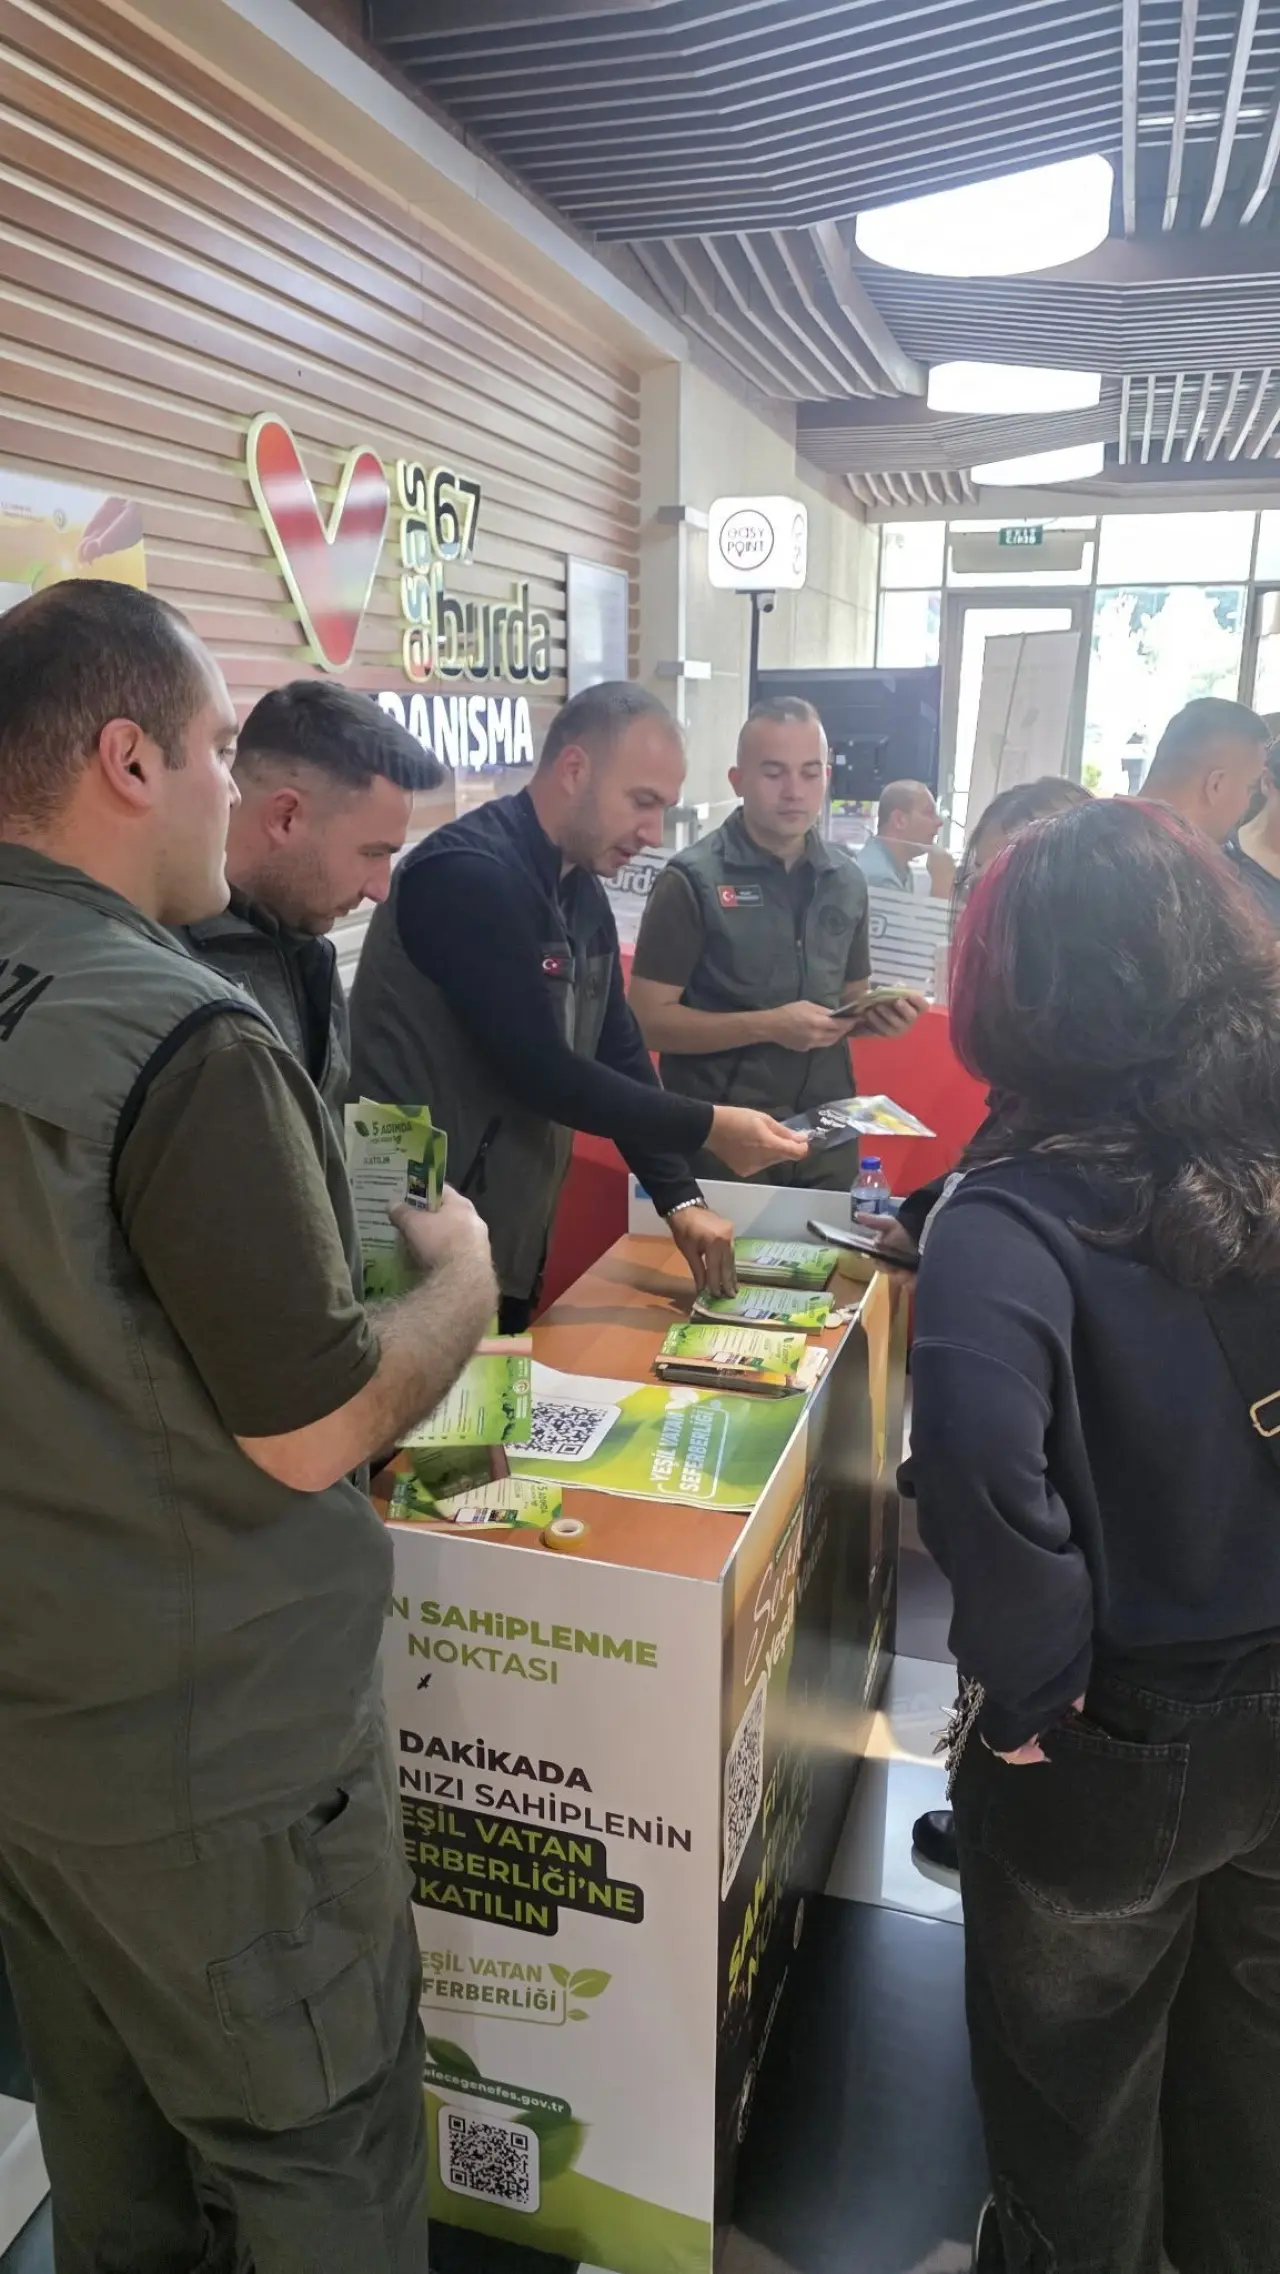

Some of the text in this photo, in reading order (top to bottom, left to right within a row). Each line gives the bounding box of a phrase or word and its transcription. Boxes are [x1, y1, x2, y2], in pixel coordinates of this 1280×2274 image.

[430, 466, 481, 564] 67
[433, 562, 551, 684] burda
[408, 1633, 558, 1684] NOKTASI
[474, 1817, 593, 1867] VATAN
[420, 1877, 549, 1928] KATILIN
[469, 1957, 542, 1983] VATAN
